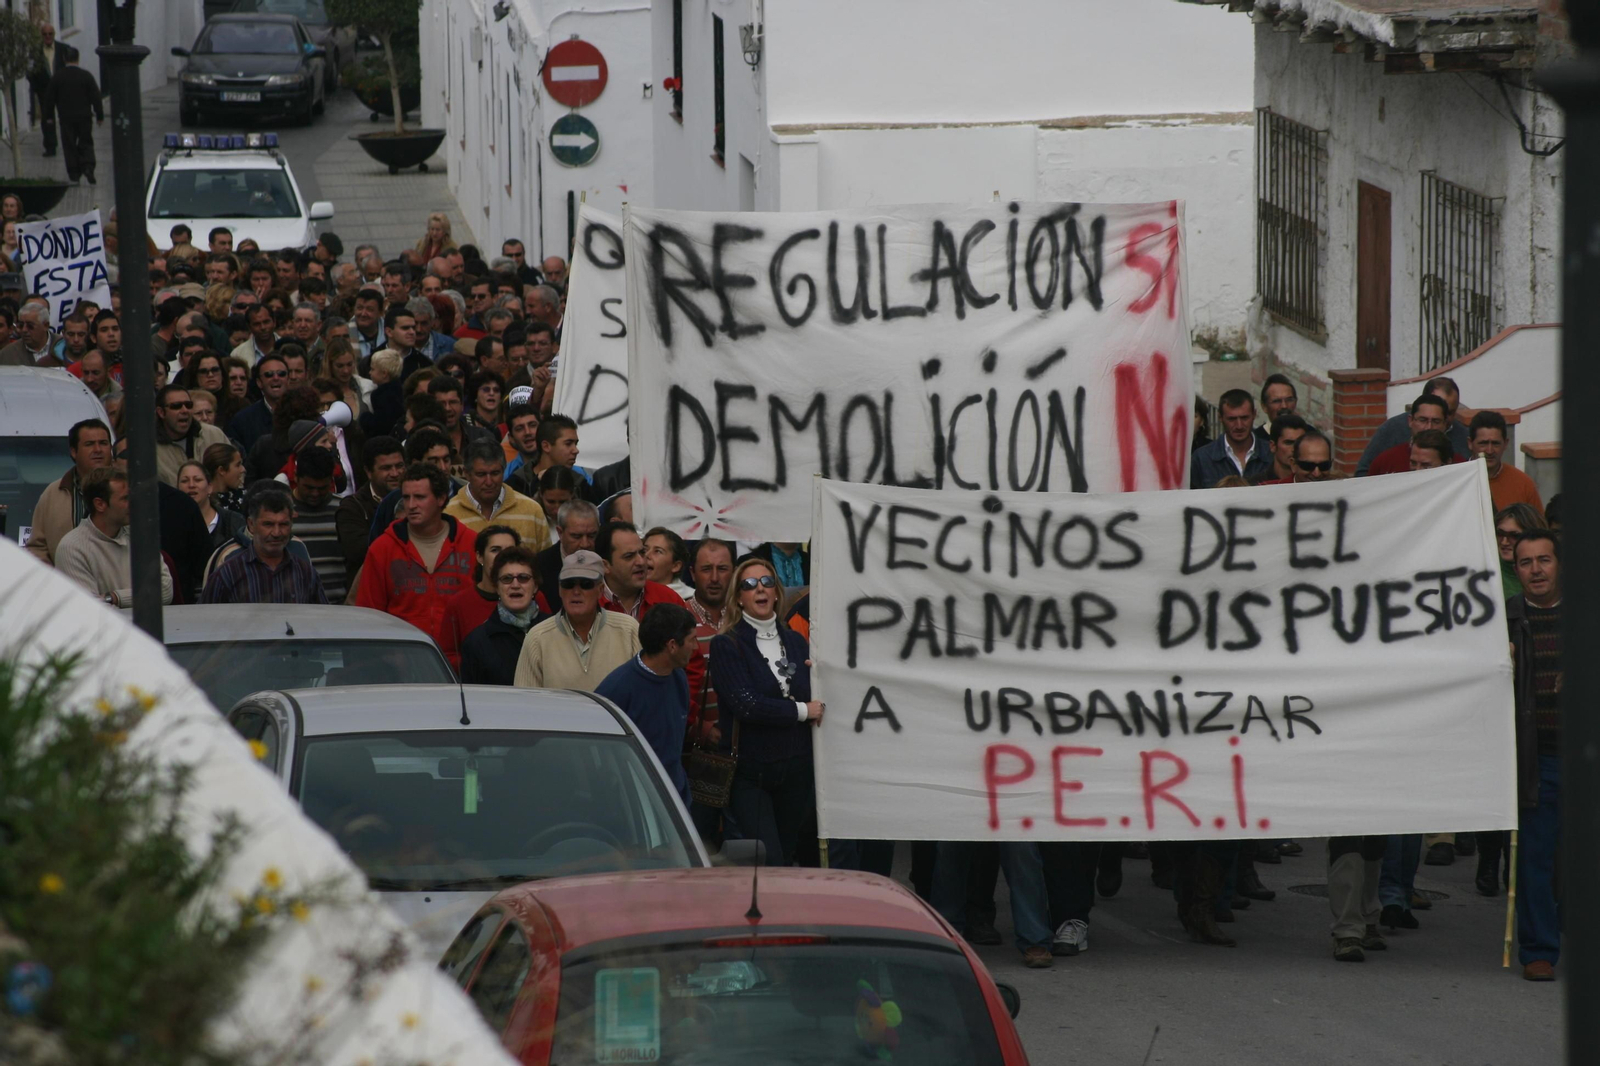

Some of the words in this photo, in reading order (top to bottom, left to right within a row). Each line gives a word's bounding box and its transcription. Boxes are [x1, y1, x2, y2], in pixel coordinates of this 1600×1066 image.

[837, 495, 1145, 579] VECINOS
[1178, 506, 1276, 577] DE
[1286, 496, 1361, 571] EL
[845, 591, 1119, 670] PALMAR
[1156, 566, 1496, 655] DISPUESTOS
[853, 685, 903, 734] A
[963, 674, 1324, 743] URBANIZAR
[982, 735, 1273, 831] P.E.R.I.
